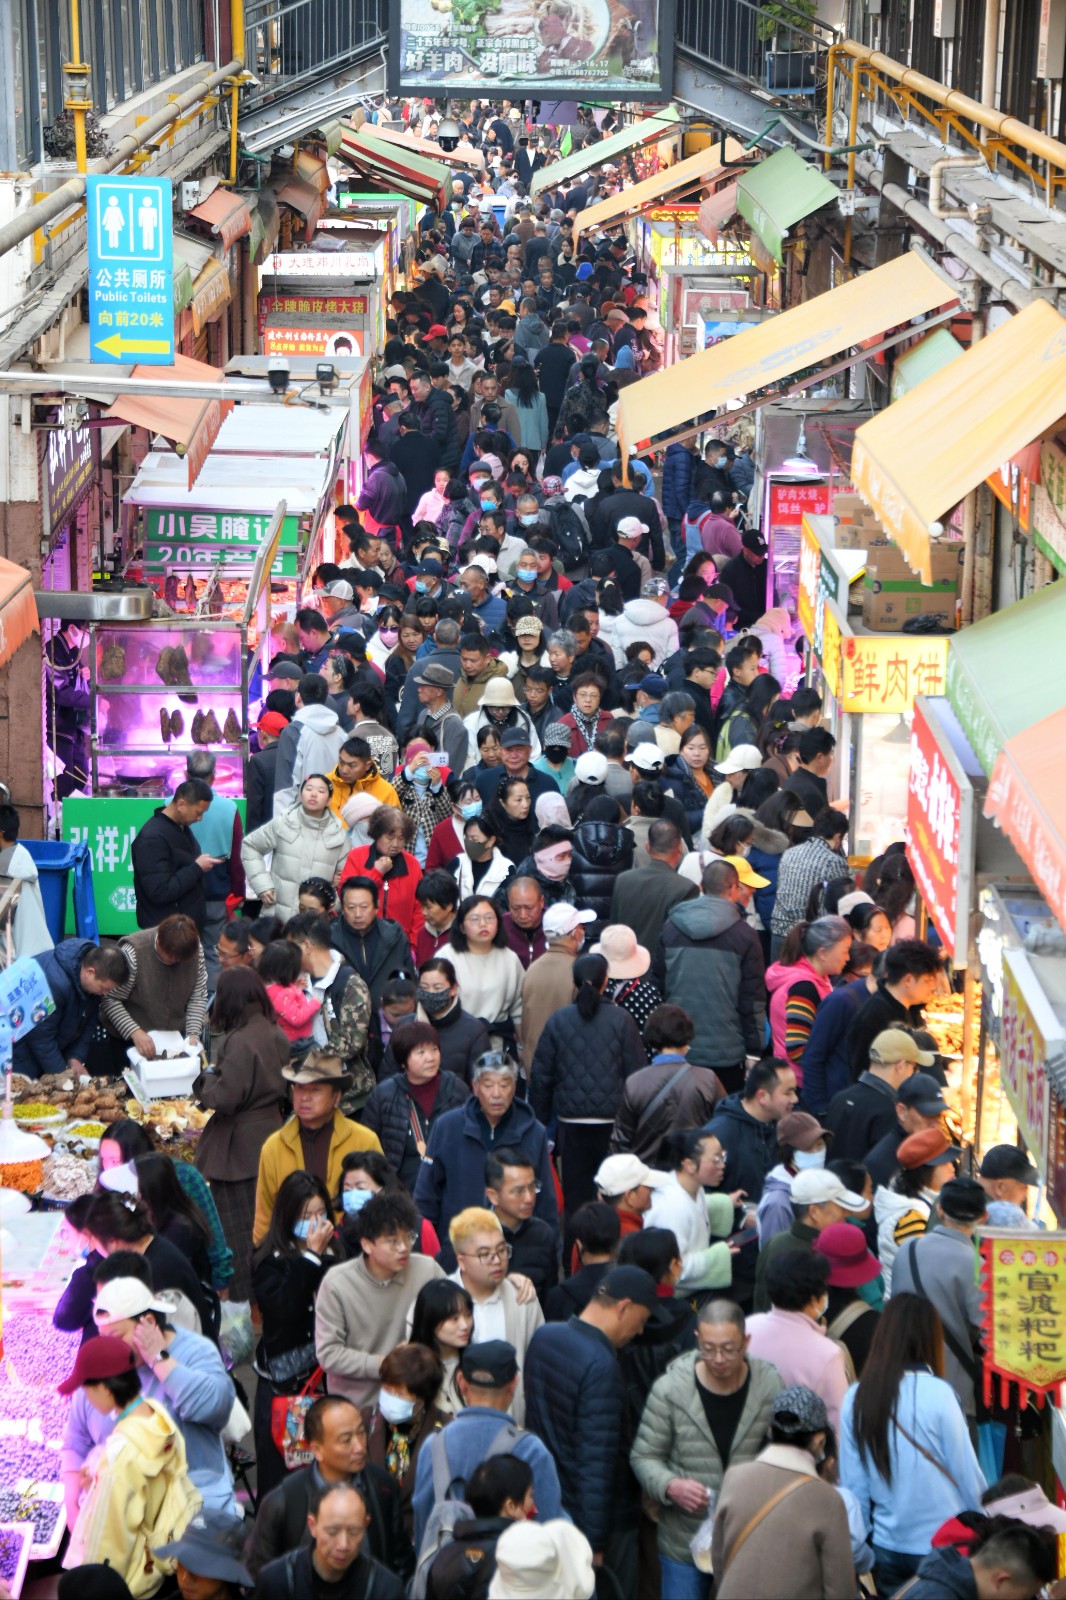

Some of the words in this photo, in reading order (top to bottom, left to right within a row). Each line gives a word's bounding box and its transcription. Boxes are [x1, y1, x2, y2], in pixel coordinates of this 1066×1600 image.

[96, 268, 166, 289] 公共厕所
[94, 289, 128, 303] Public
[130, 291, 168, 304] Toilets
[98, 310, 165, 328] 向前20米
[157, 513, 273, 541] 小吴腌记
[850, 652, 944, 704] 鲜肉饼
[1016, 1269, 1064, 1363] 官渡粑粑
